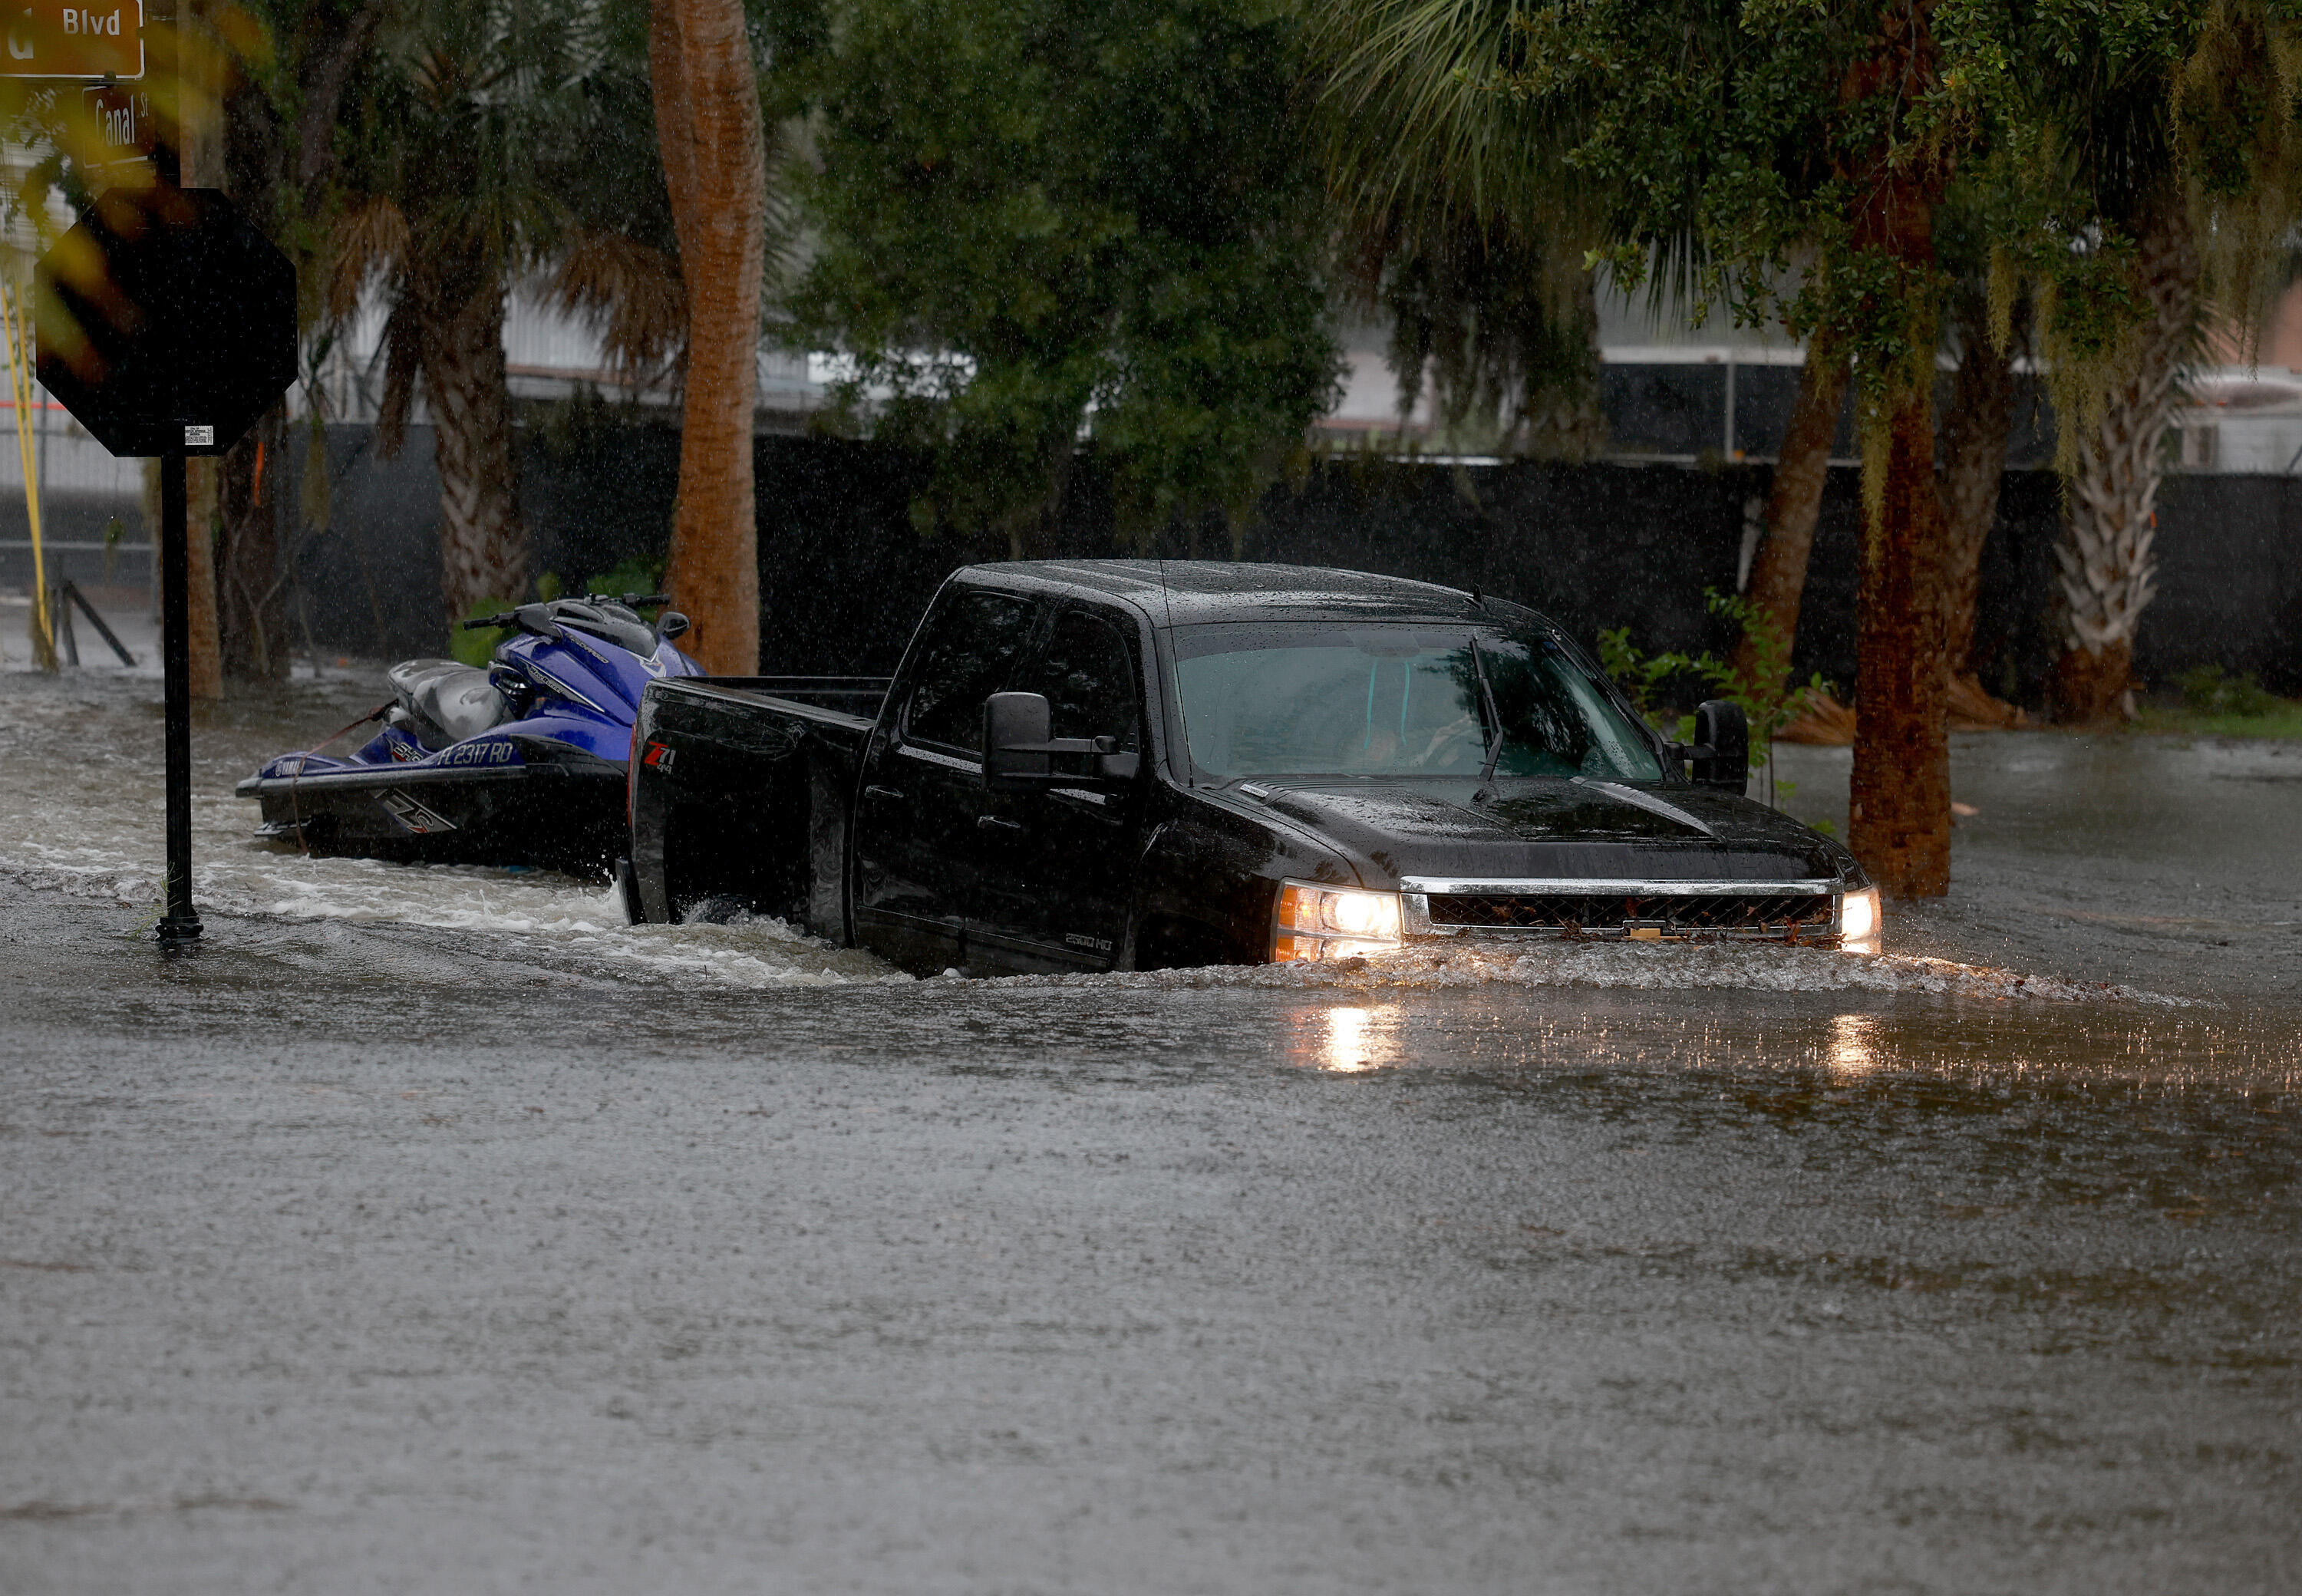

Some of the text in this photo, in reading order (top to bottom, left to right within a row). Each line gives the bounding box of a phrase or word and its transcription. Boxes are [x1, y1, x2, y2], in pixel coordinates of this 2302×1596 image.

[63, 8, 120, 35] Blvd
[95, 92, 148, 147] Canal St
[437, 742, 513, 766] FL 2317 RD
[644, 740, 677, 766] Z71
[1066, 932, 1095, 948] 2500
